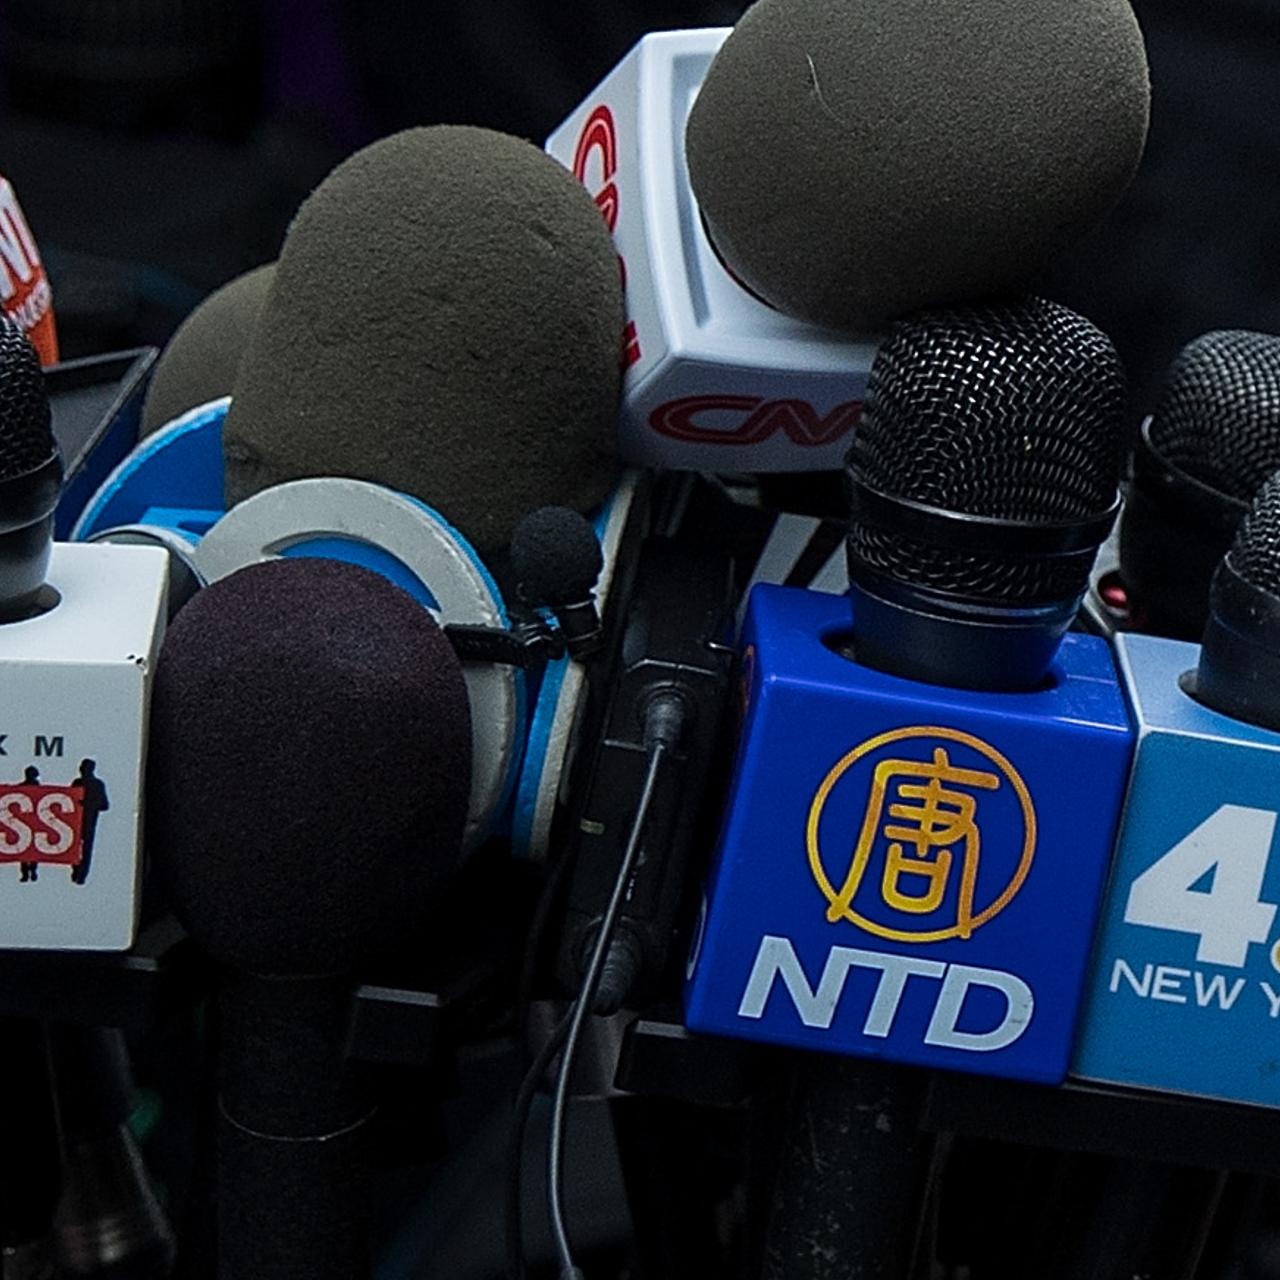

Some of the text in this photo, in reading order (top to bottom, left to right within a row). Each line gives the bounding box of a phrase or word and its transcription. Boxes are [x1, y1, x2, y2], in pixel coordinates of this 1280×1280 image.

[648, 394, 865, 448] CN
[826, 747, 999, 939] 唐
[1123, 803, 1278, 968] 4
[737, 934, 1034, 1052] NTD
[1109, 958, 1246, 1011] NEW
